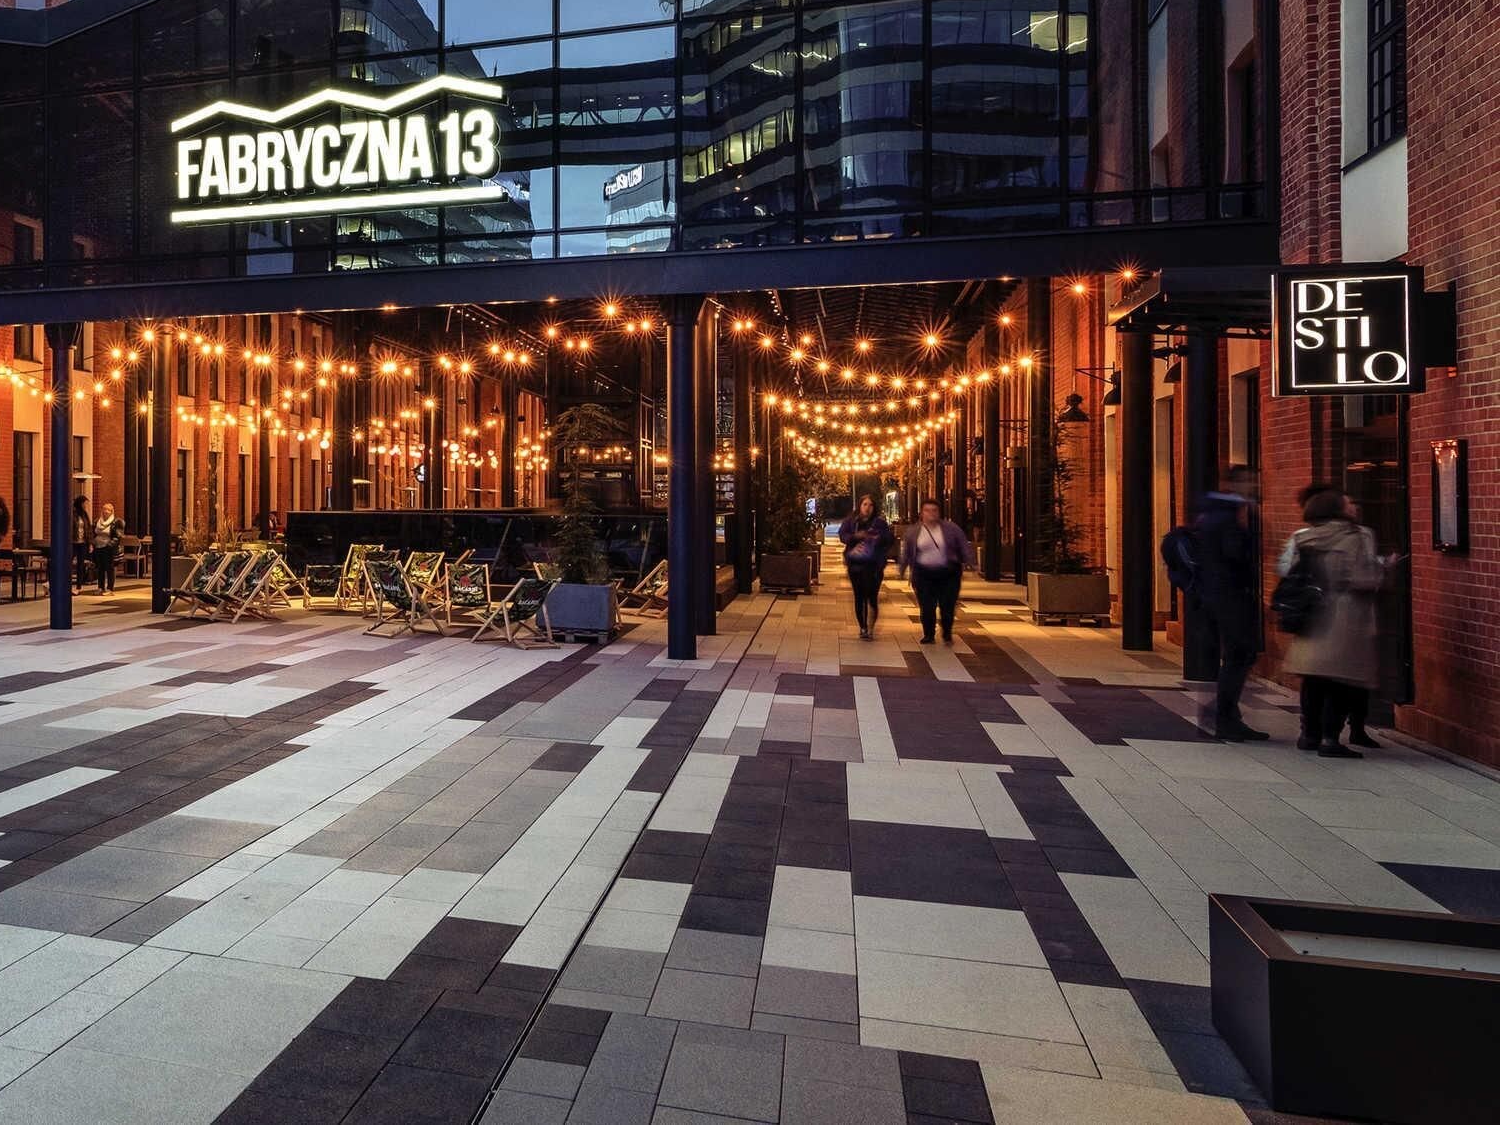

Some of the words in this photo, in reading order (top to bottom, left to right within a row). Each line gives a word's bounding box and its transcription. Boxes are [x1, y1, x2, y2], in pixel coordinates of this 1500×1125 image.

[177, 115, 434, 199] FABRYCZNA
[438, 109, 497, 176] 13
[1298, 280, 1363, 313] DE
[1337, 351, 1407, 383] LO
